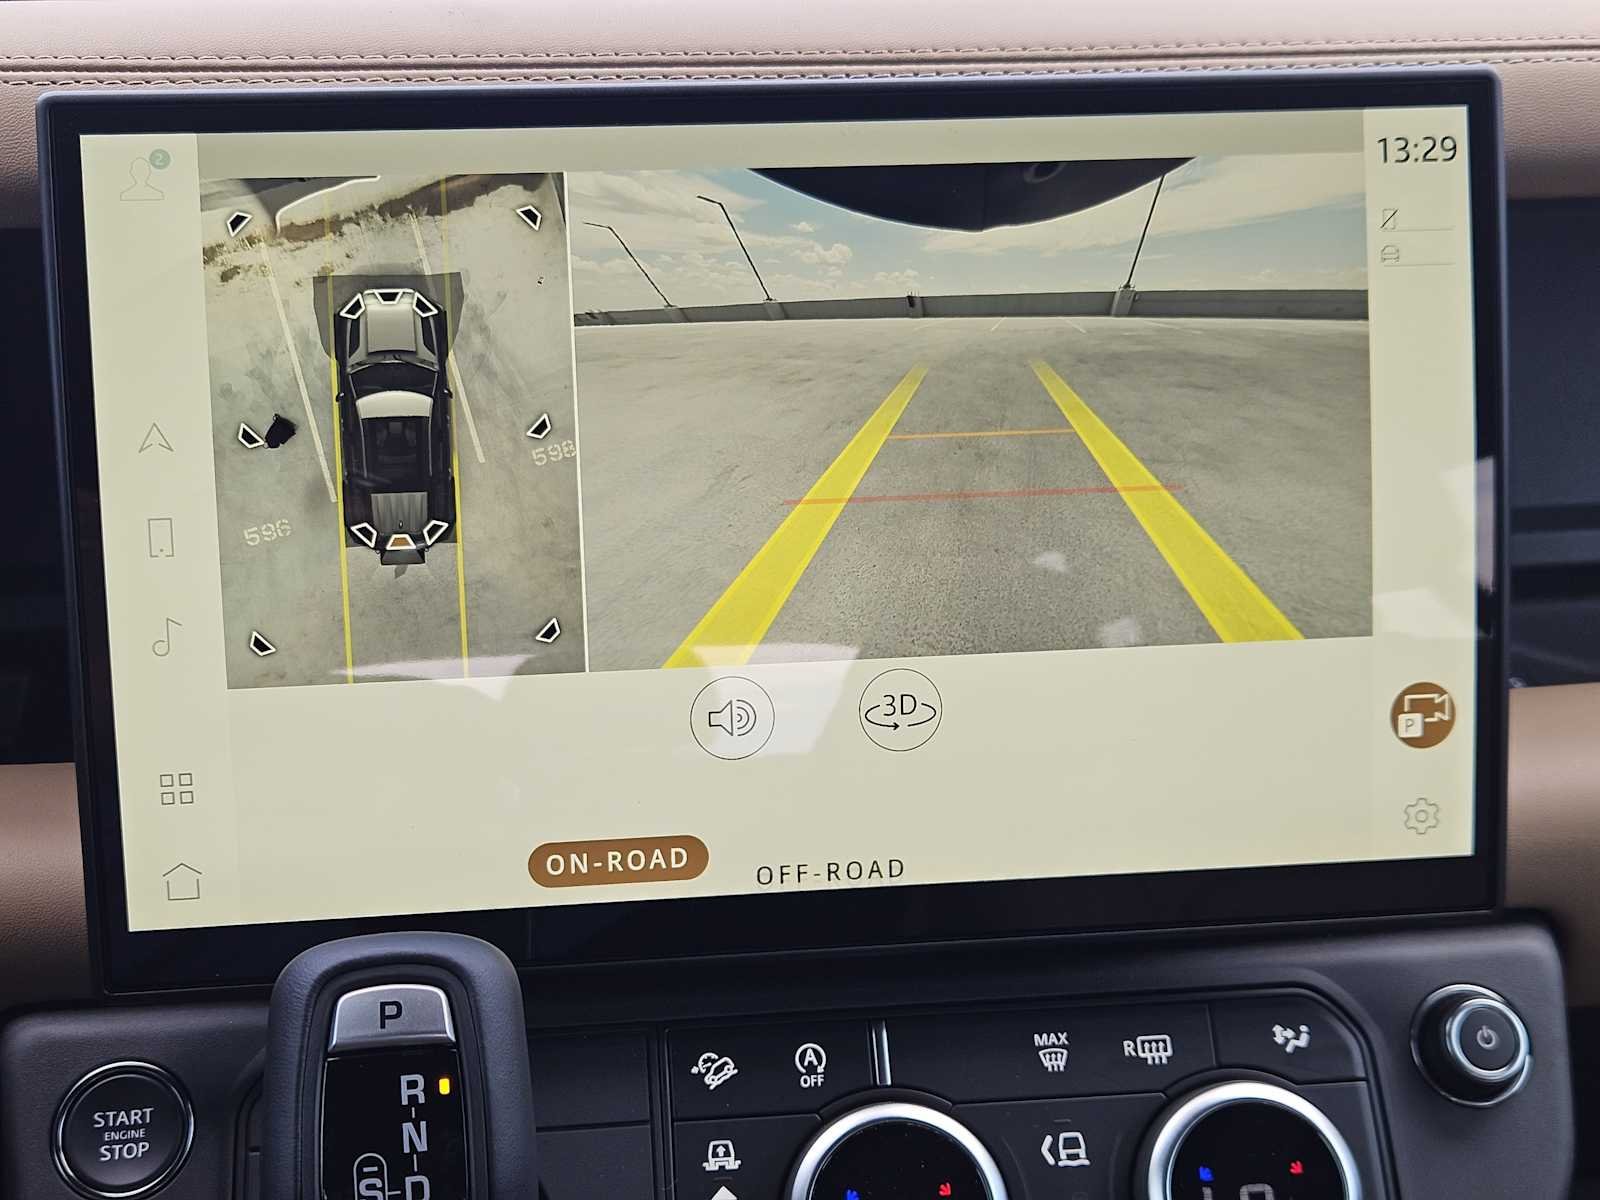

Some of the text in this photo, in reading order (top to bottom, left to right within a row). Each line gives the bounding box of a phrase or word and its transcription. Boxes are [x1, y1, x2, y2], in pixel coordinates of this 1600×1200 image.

[1376, 135, 1457, 164] 13:29
[532, 440, 577, 466] 598
[243, 519, 291, 546] 596
[883, 693, 917, 717] 3D
[1404, 718, 1415, 734] P
[545, 846, 689, 876] ON-ROAD
[756, 858, 905, 886] OFF-ROAD
[379, 1000, 403, 1030] P
[1033, 1031, 1069, 1047] MAX
[1122, 1040, 1137, 1057] R
[803, 1048, 818, 1067] A
[400, 1074, 426, 1106] R
[800, 1074, 825, 1088] OFF
[93, 1107, 154, 1128] START
[104, 1128, 146, 1141] ENGINE
[402, 1120, 428, 1154] N
[100, 1141, 150, 1162] STOP
[404, 1174, 431, 1200] D
